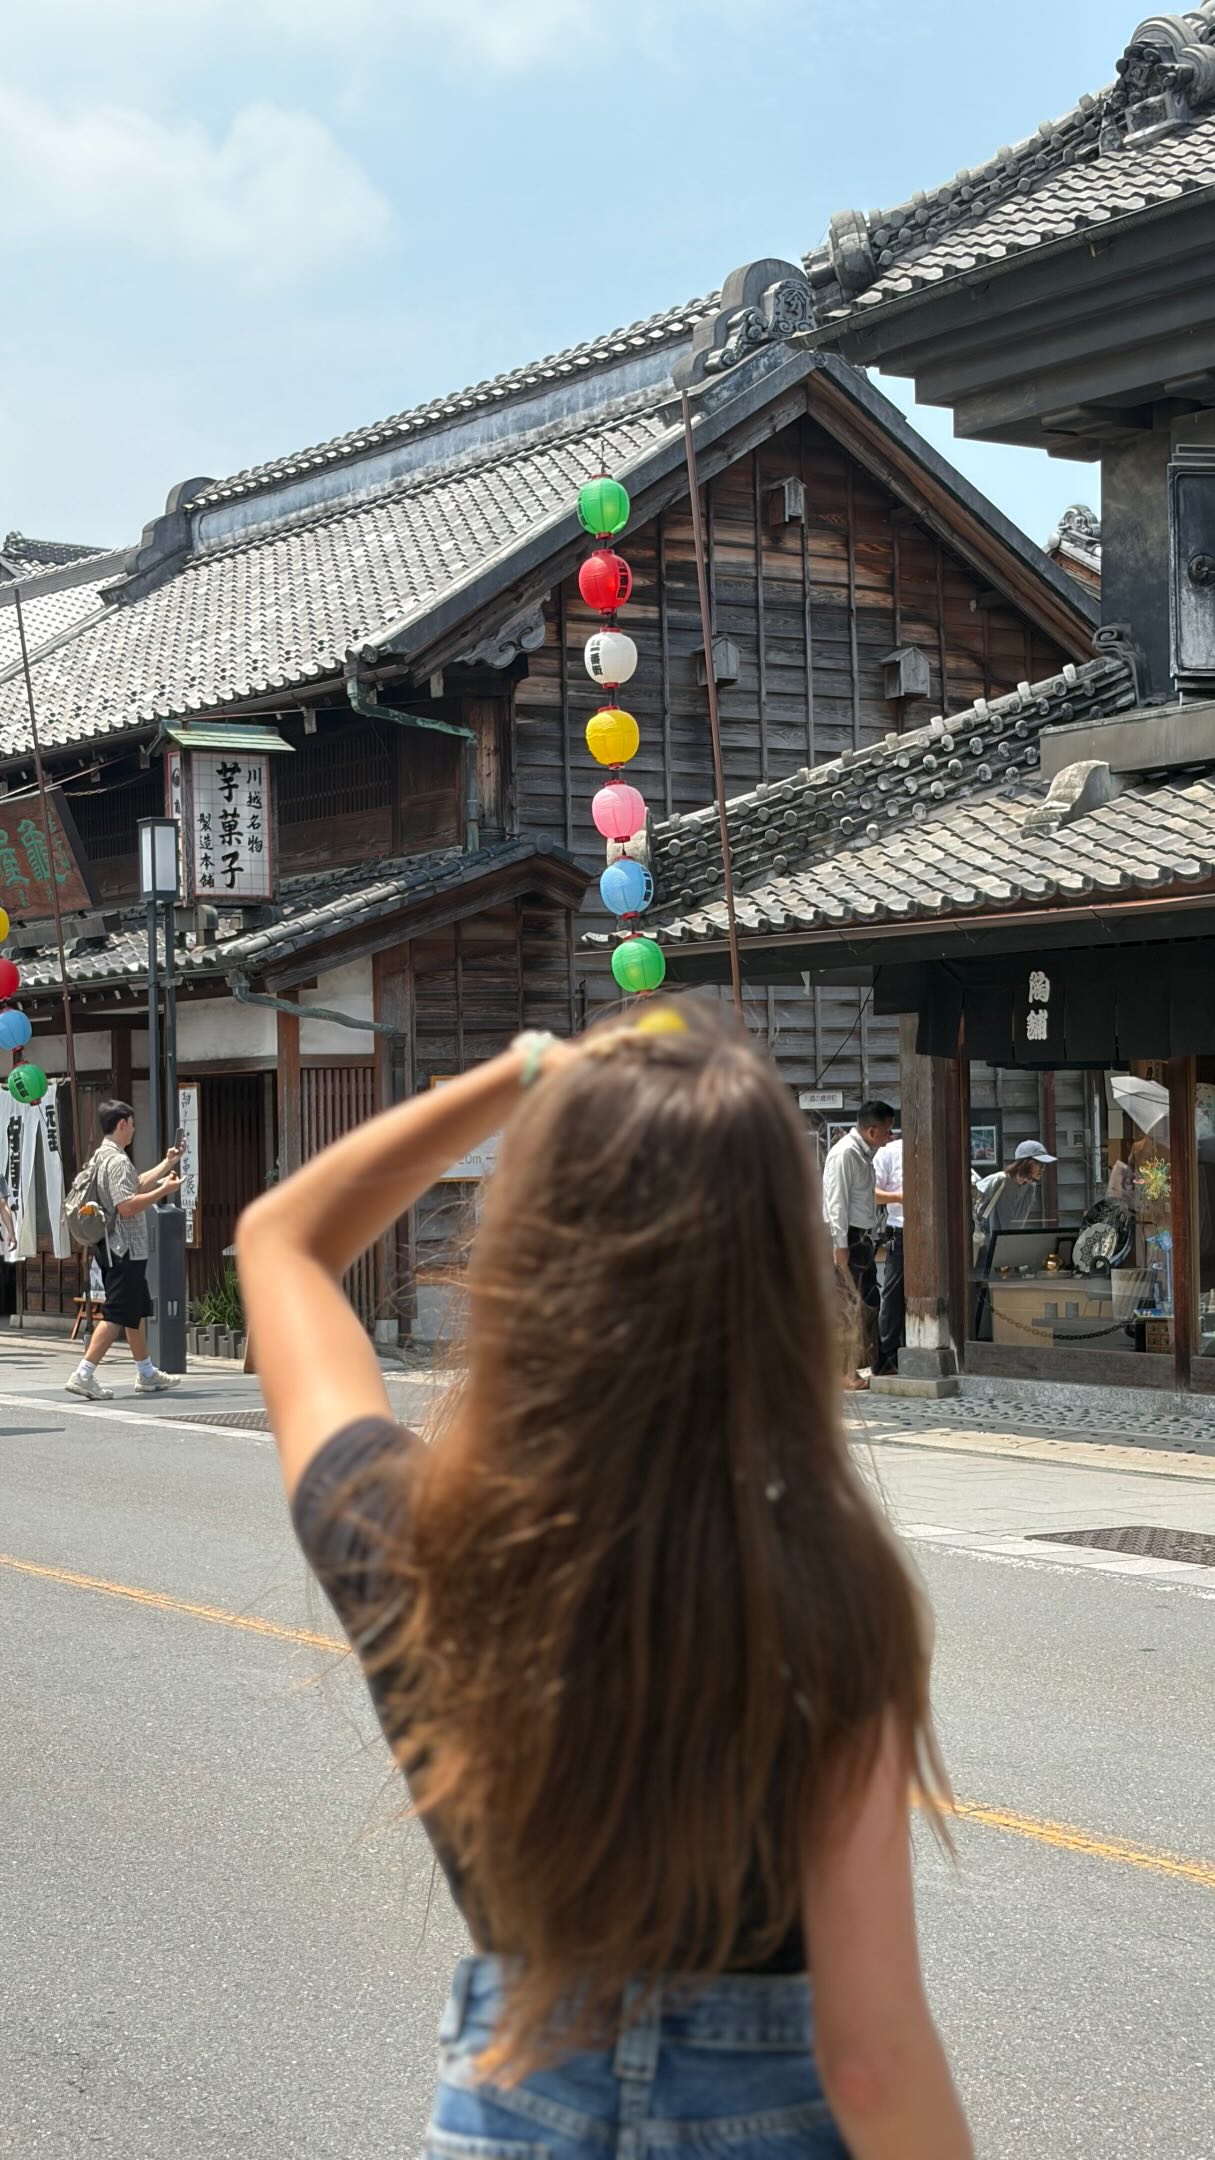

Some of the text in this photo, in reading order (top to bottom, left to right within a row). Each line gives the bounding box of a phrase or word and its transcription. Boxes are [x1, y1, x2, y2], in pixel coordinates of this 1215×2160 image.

[216, 761, 245, 889] 芋菓子
[246, 767, 264, 853] 川越名物
